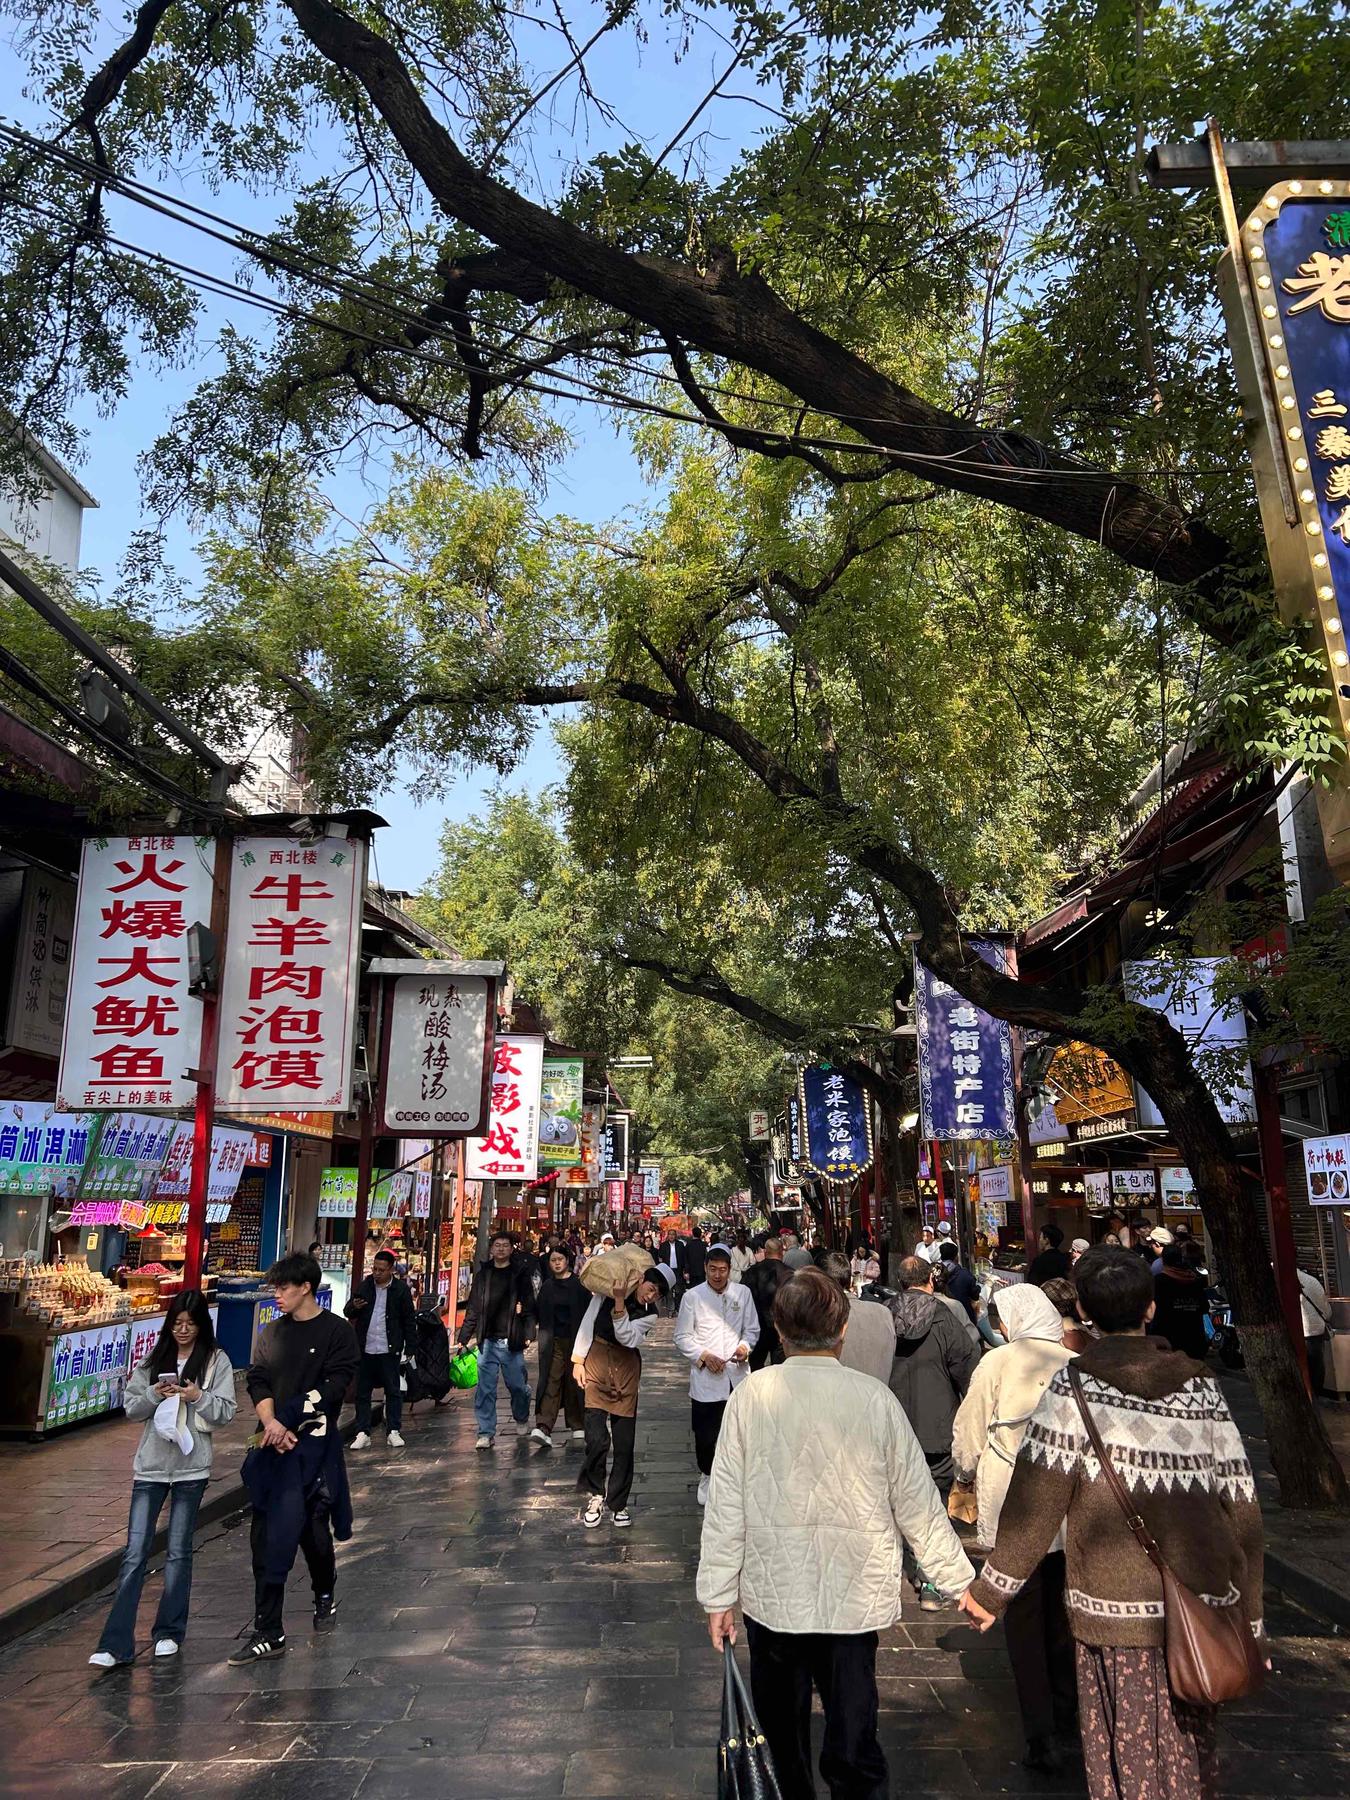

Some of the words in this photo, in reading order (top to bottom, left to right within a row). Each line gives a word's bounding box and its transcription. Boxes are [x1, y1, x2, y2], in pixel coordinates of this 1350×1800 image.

[1282, 252, 1350, 323] 老
[128, 836, 176, 851] 西北楼
[239, 852, 256, 868] 清
[269, 850, 318, 865] 西北楼
[329, 851, 346, 867] 真
[88, 853, 189, 1086] 火爆大鱿鱼
[232, 873, 335, 1091] 牛羊肉泡馍
[421, 1010, 453, 1101] 酸梅汤
[948, 1006, 985, 1124] 老街特产店
[82, 1090, 173, 1105] 舌尖上的美味
[477, 1041, 523, 1160] 皮影戏
[822, 1074, 854, 1162] 老米家泡馍
[0, 1125, 88, 1165] 筒冰淇淋
[100, 1127, 168, 1160] 竹筒冰淇淋
[826, 1163, 858, 1172] 老字号
[1114, 1174, 1155, 1188] 肚包肉
[55, 1340, 128, 1383] 竹筒冰淇淋
